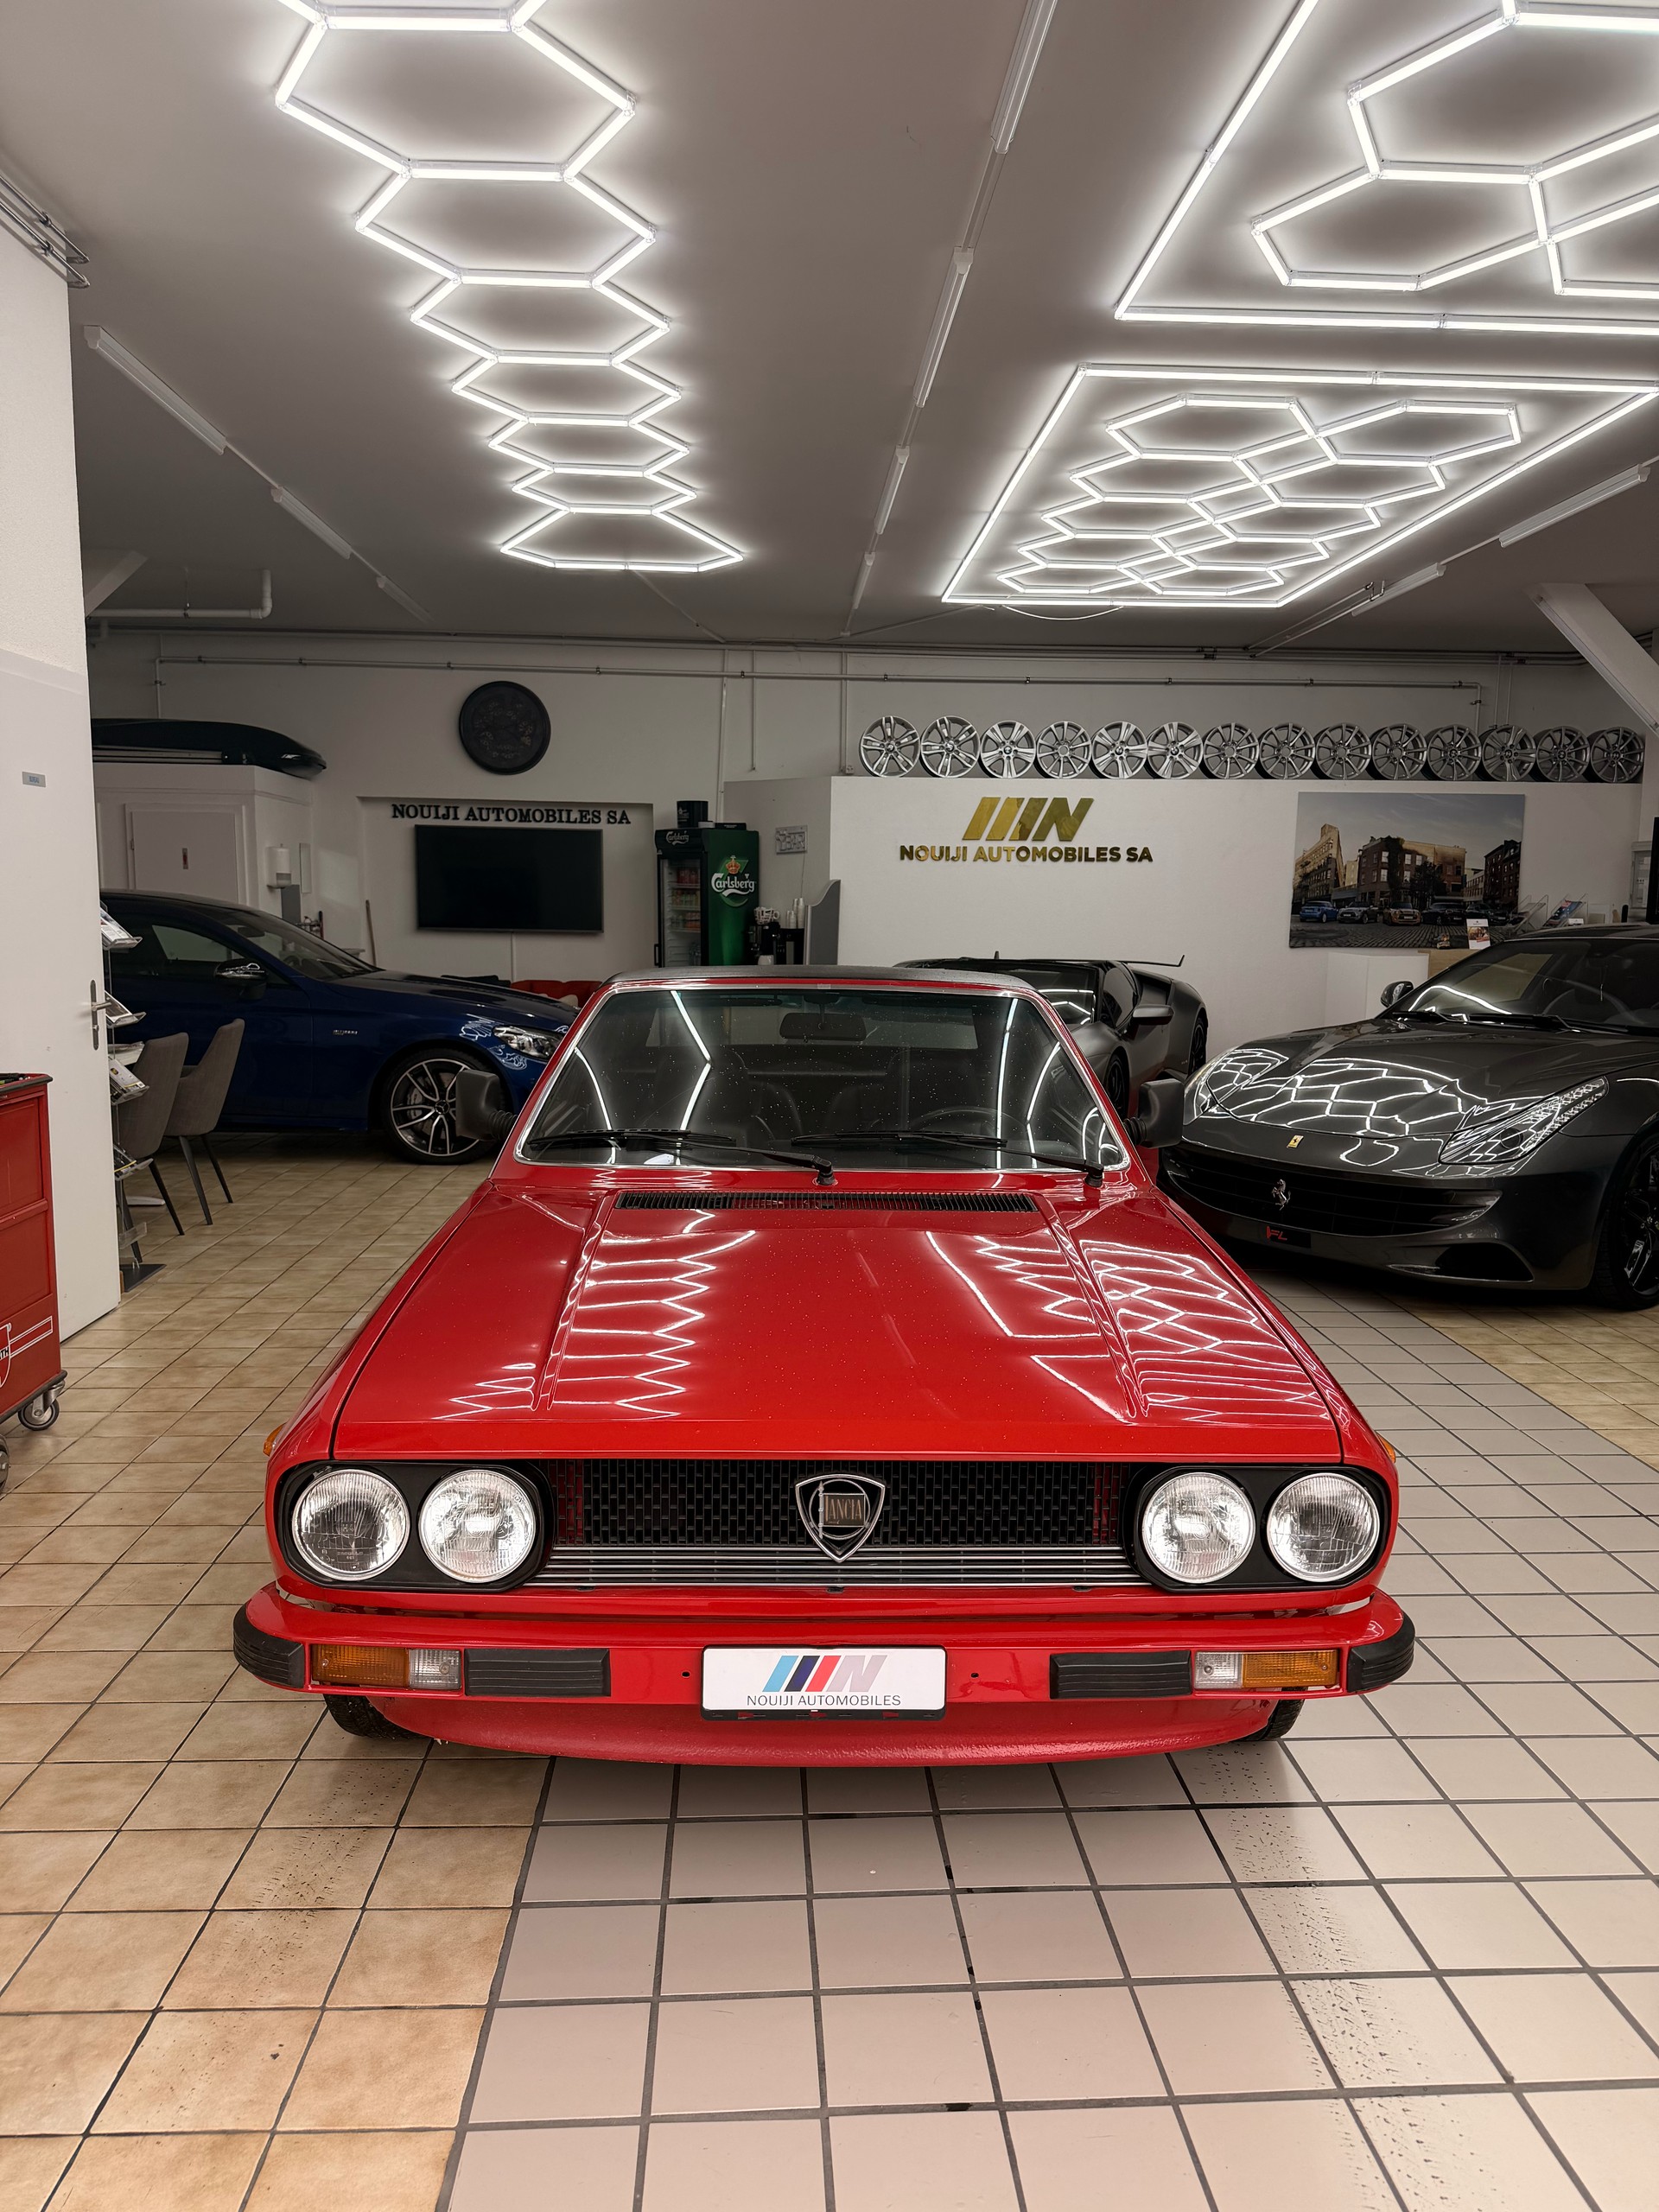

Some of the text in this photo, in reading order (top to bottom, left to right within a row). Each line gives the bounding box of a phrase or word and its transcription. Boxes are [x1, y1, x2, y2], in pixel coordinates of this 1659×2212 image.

[391, 804, 631, 824] NOUIJI AUTOMOBILES SA
[666, 830, 690, 845] Carlsberg
[899, 845, 1154, 862] NOUIJI AUTOMOBILES SA
[711, 873, 755, 897] Carlsberg
[825, 1496, 862, 1524] LANCIA
[747, 1694, 901, 1707] NOUIJI AUTOMOBILES
